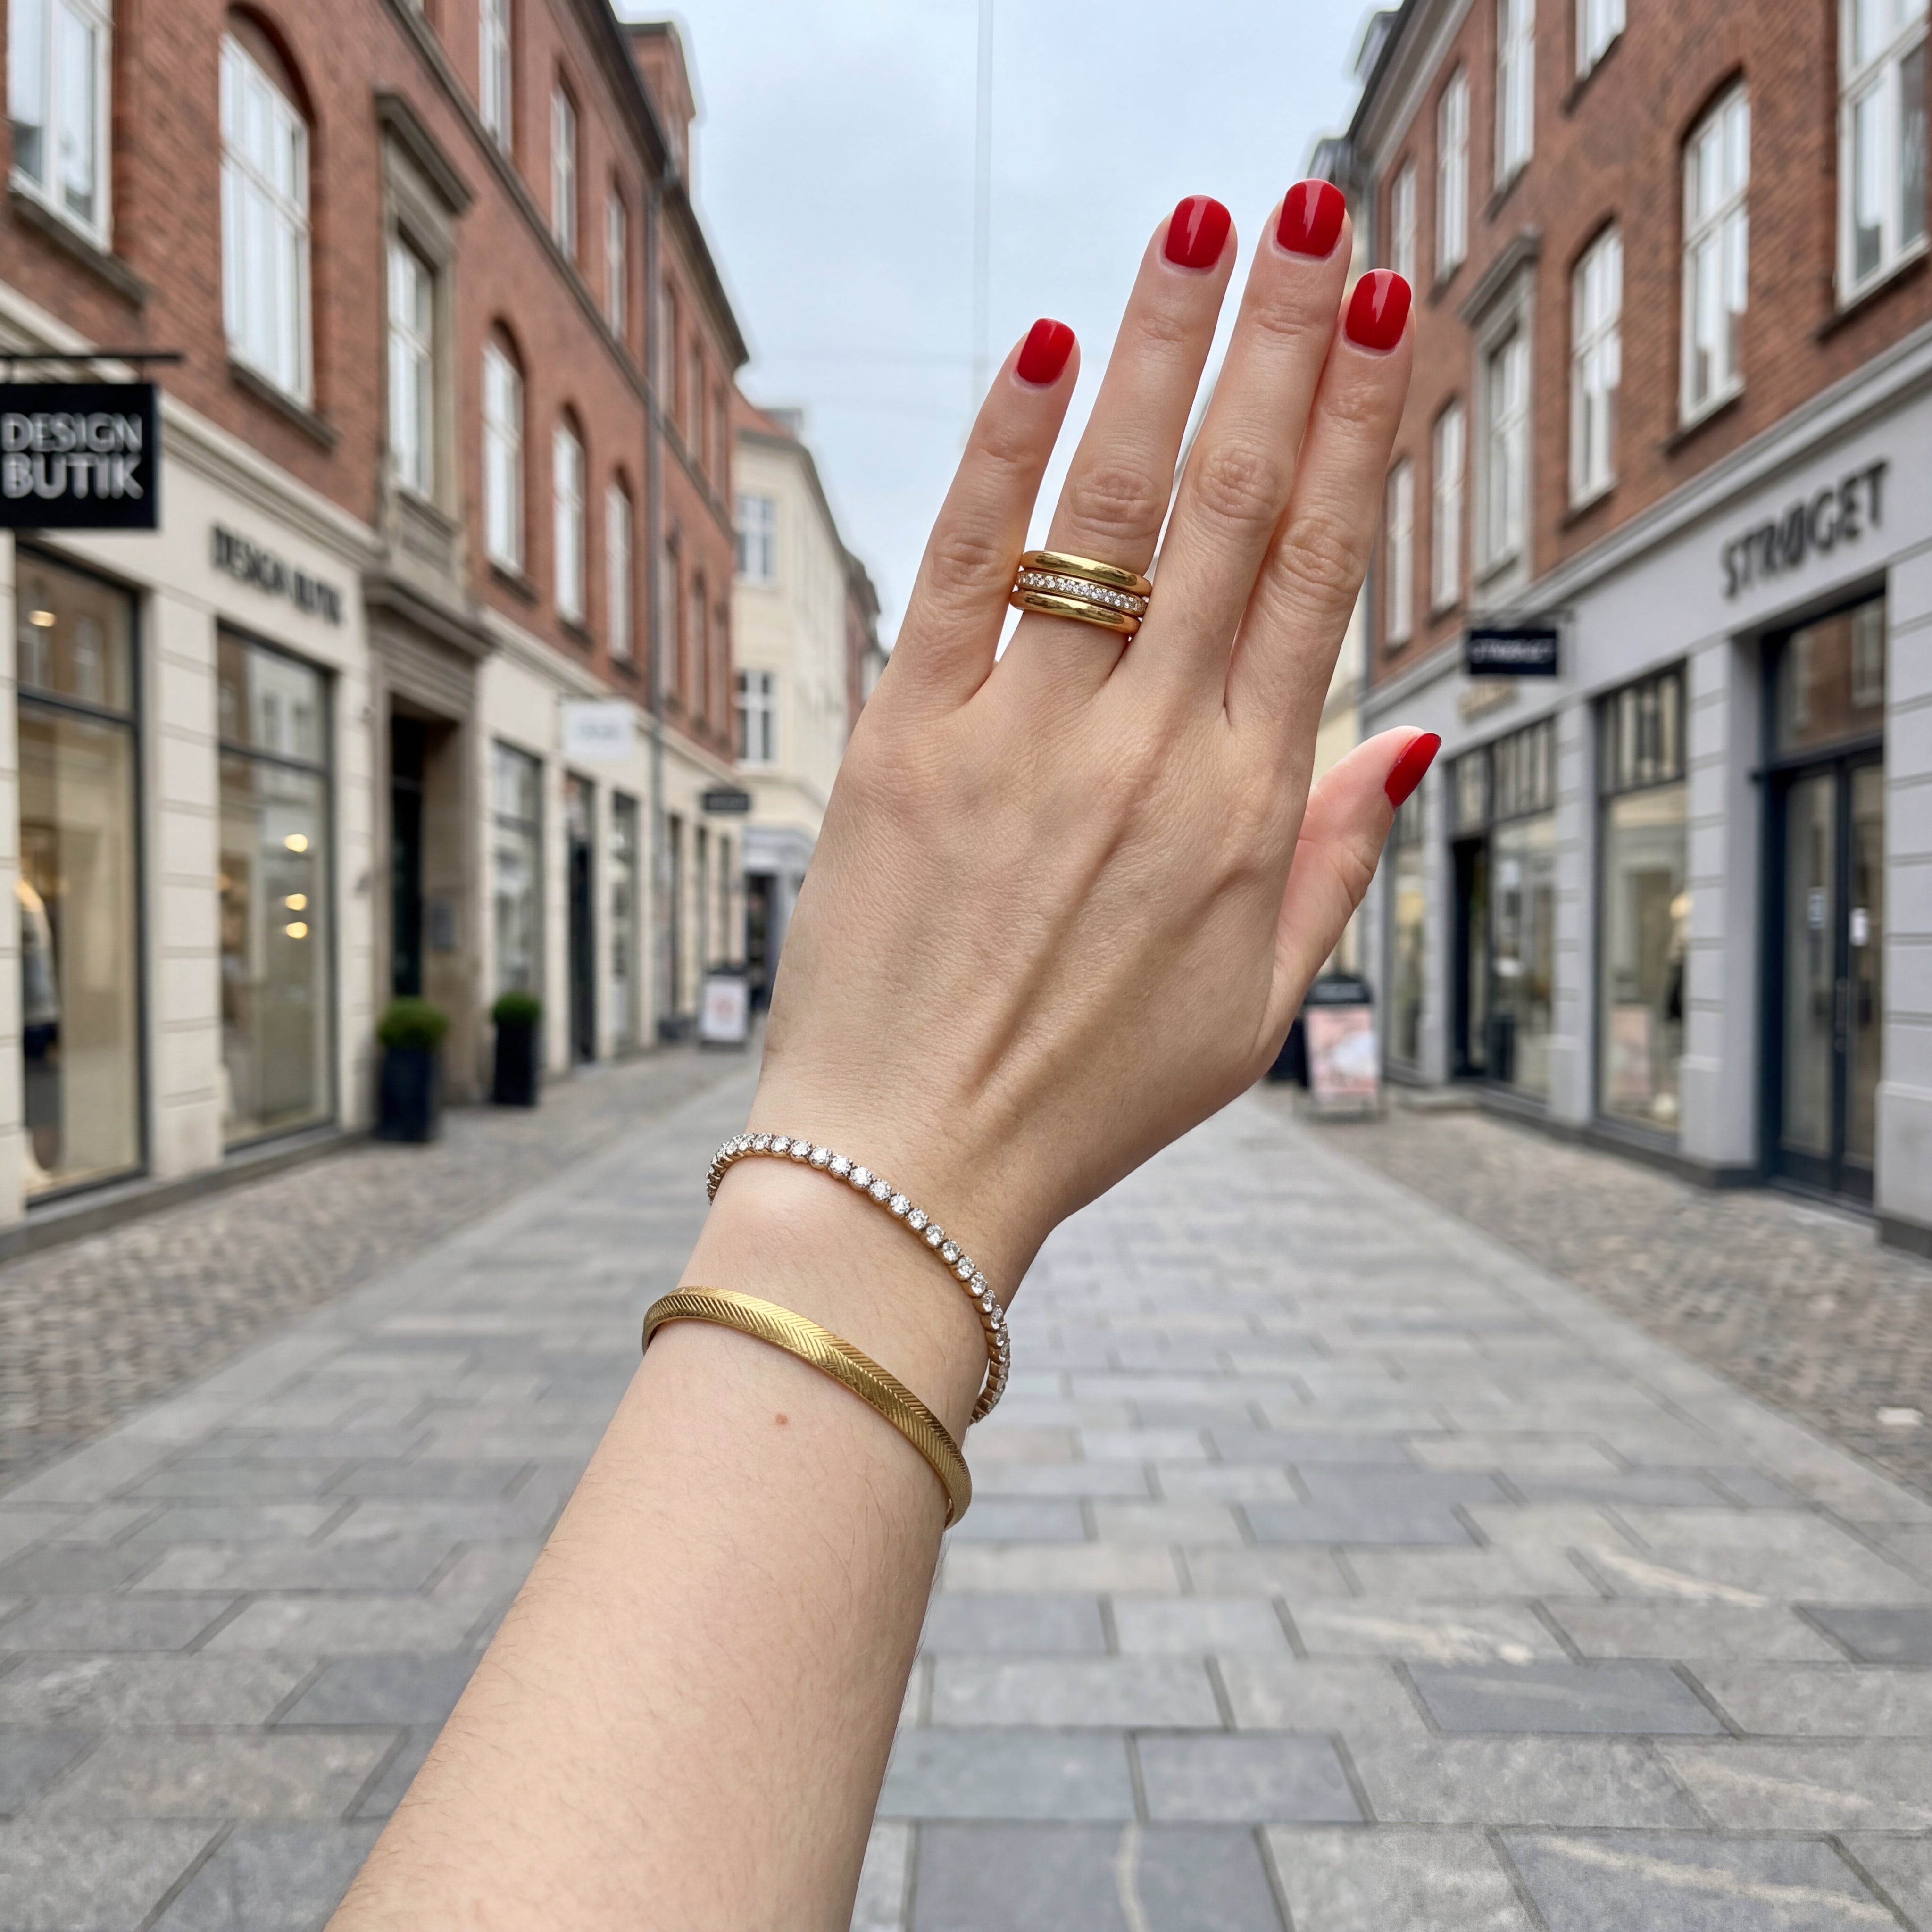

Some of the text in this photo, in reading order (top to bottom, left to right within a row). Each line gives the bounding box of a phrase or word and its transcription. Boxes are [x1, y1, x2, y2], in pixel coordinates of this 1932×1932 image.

[2, 412, 142, 452] DESIGN
[3, 452, 143, 499] BUTIK
[1720, 457, 1890, 598] STRØGET
